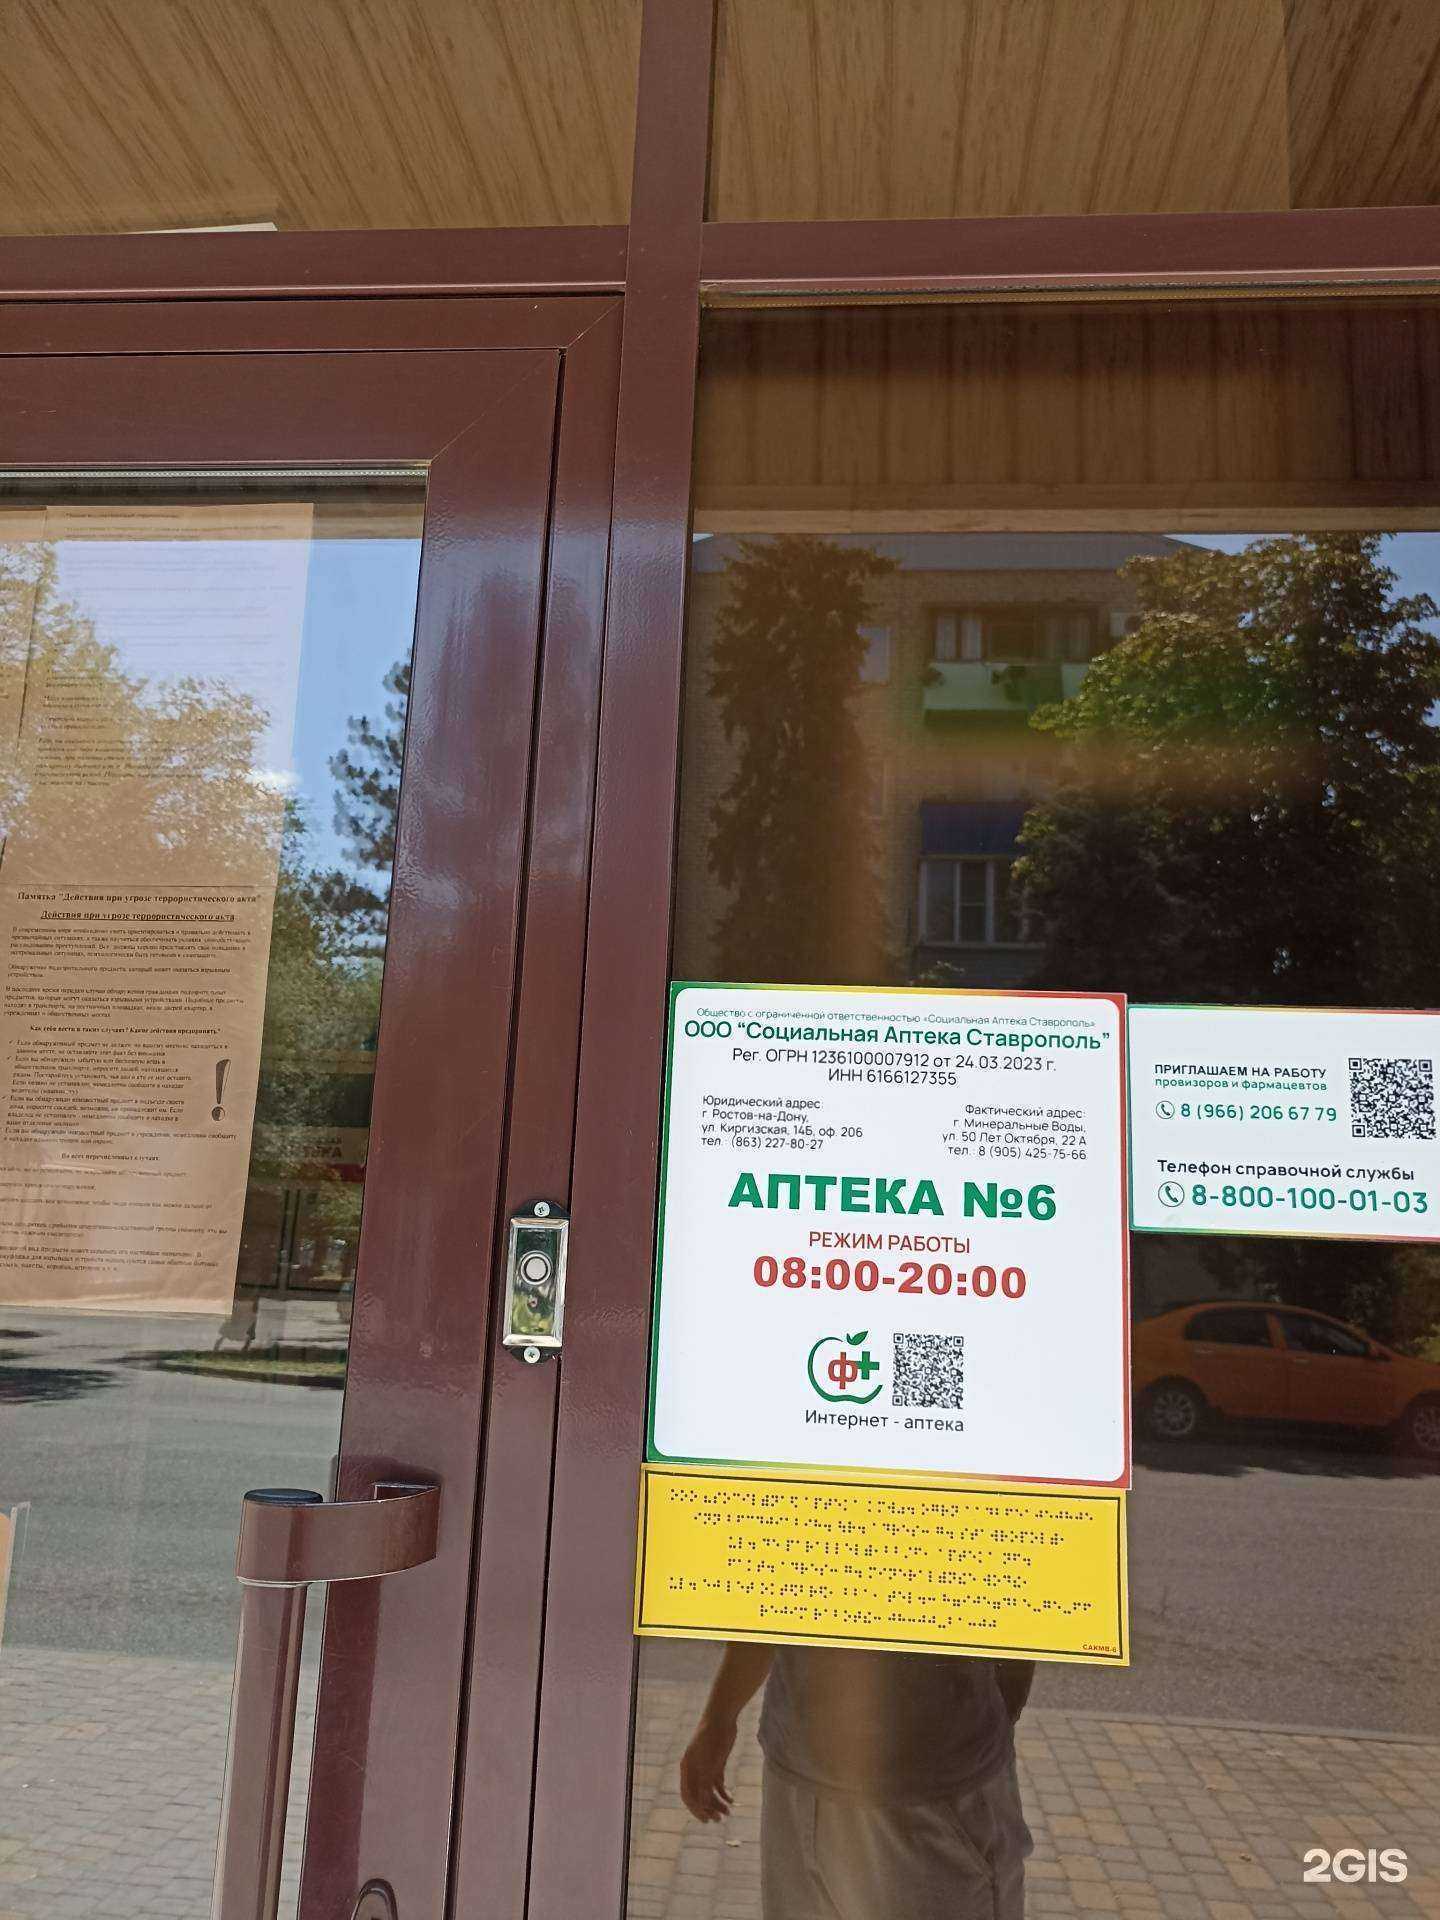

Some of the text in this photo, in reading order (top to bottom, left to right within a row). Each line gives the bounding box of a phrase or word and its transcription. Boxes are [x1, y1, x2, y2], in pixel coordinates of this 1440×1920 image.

[697, 1007, 745, 1018] Общество
[747, 1010, 754, 1018] с
[755, 1009, 825, 1020] ограниченной
[827, 1012, 921, 1024] ответственностью
[992, 1015, 1027, 1026] Аптека
[684, 1020, 732, 1039] ООО
[884, 1026, 961, 1046] Аптека
[732, 1047, 1056, 1071] Рег. ОГРН 1236100007912 от 24.03.2023 г.
[828, 1068, 957, 1086] ИНН 6166127355
[1154, 1063, 1326, 1079] ПРИГЛАШАЕМ НА РАБОТУ
[1154, 1078, 1229, 1090] провизоров
[1241, 1079, 1328, 1092] фармацевтов
[702, 1094, 783, 1109] Юридический
[965, 1104, 1044, 1117] Фактический
[1180, 1103, 1191, 1118] 8
[1196, 1103, 1244, 1121] (966)
[1250, 1104, 1283, 1121] 206
[840, 1126, 863, 1138] 206
[964, 1118, 1049, 1131] Минеральные
[1051, 1121, 1086, 1133] Воды,
[731, 1134, 761, 1149] (863)
[765, 1137, 824, 1150] 227-80-27
[961, 1131, 976, 1143] 50
[979, 1132, 1001, 1143] Лет
[1061, 1135, 1076, 1146] 22
[978, 1145, 986, 1156] 8
[990, 1146, 1021, 1159] (905)
[1025, 1147, 1087, 1160] 425-75-66
[1156, 1159, 1415, 1182] Телефон справочной службы
[727, 1171, 1058, 1221] АПТЕКА №6
[1191, 1183, 1429, 1214] 8-800-100-01-03
[808, 1231, 970, 1254] РЕЖИМ РАБОТЫ
[753, 1255, 1027, 1299] 08:00-20:00
[804, 1409, 889, 1430] Интернет
[903, 1415, 965, 1432] аптека
